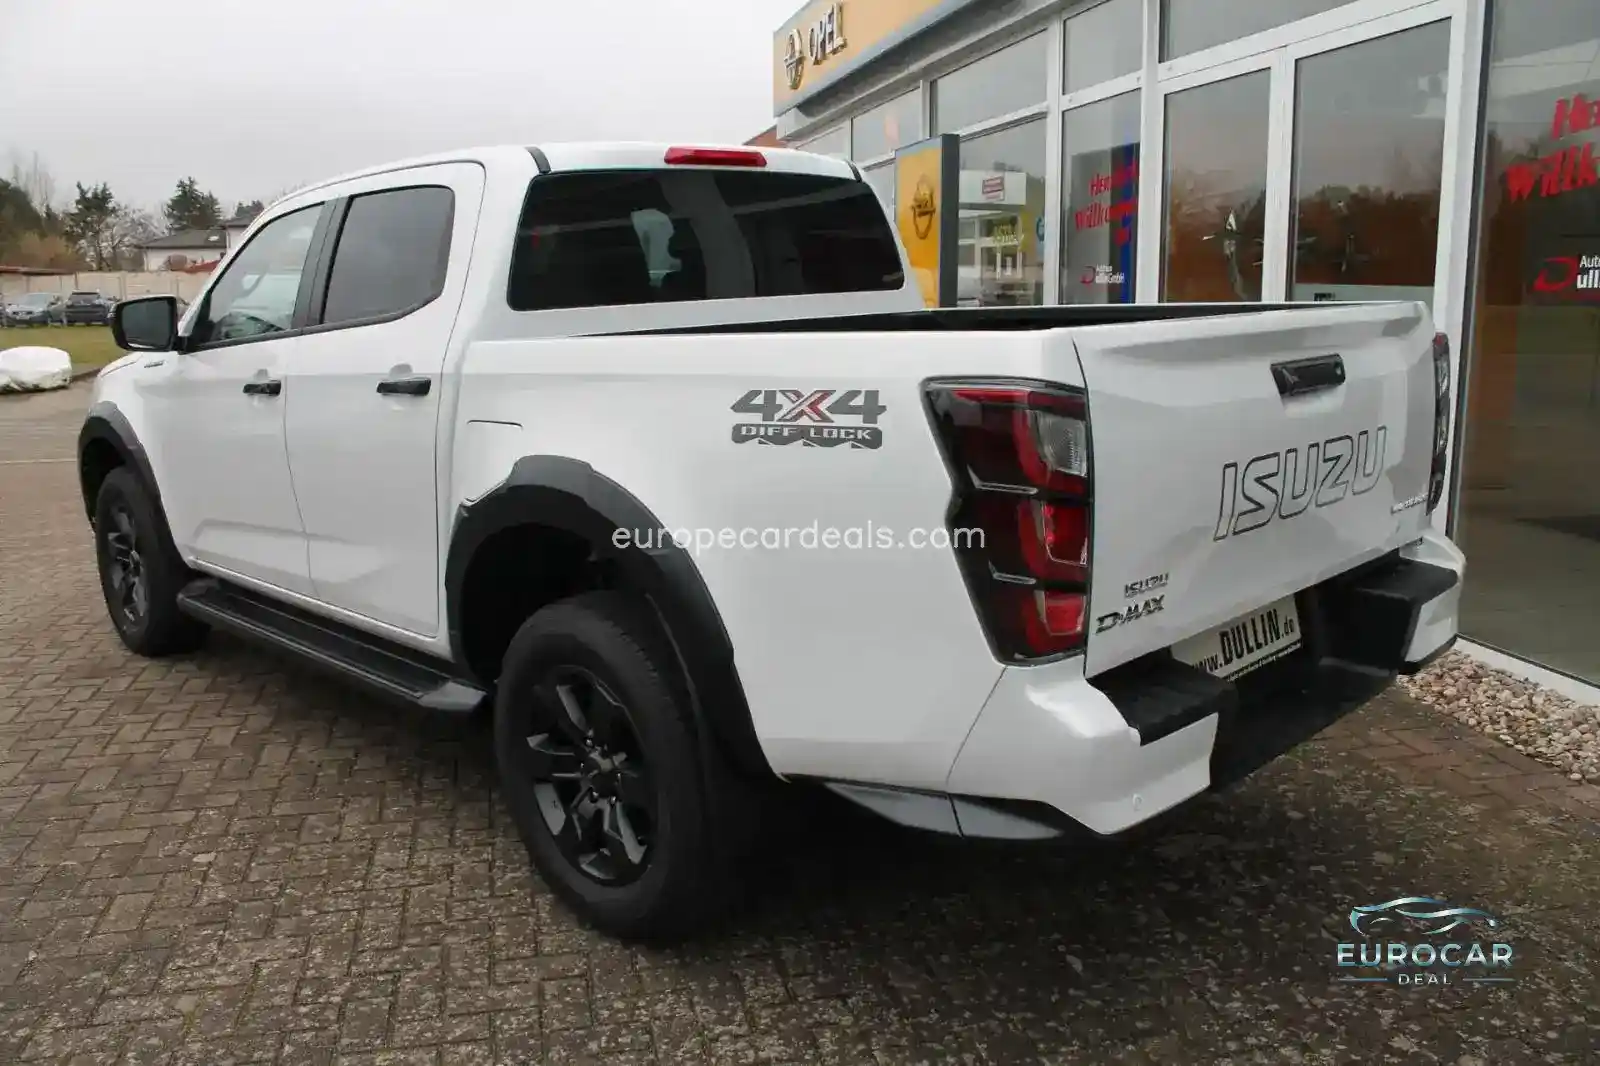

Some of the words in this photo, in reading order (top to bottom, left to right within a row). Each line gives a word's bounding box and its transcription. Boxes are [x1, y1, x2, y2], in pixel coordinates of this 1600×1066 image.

[808, 3, 847, 65] OPEL
[1506, 142, 1600, 203] Willk
[741, 426, 798, 437] DIFF
[809, 427, 872, 440] LOCK
[1213, 426, 1387, 541] ISUZU
[1125, 572, 1169, 598] ISUZU
